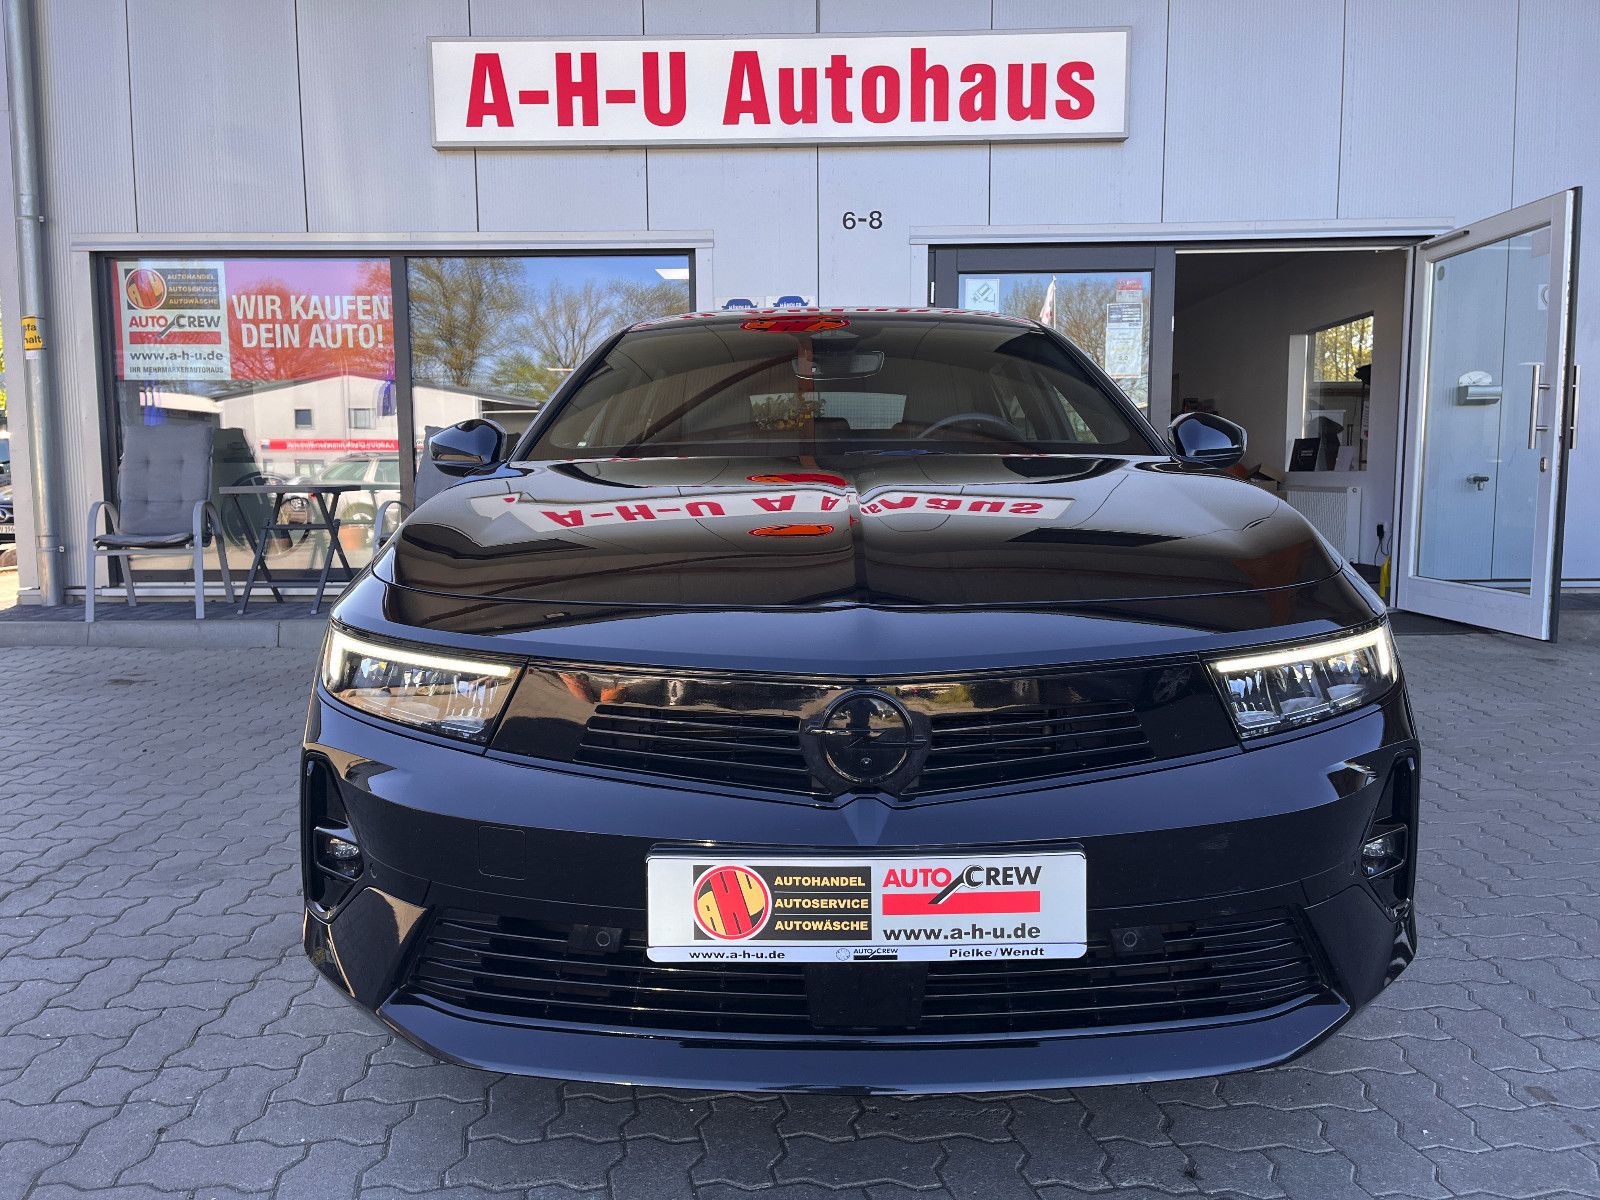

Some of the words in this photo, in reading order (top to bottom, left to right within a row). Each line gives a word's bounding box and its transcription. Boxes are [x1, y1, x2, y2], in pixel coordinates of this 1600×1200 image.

[465, 52, 687, 128] A-H-U
[722, 48, 1095, 126] Autohaus
[841, 210, 883, 230] 6-8
[232, 295, 282, 320] WIR
[291, 295, 390, 320] KAUFEN
[129, 315, 168, 328] AUTO
[176, 313, 221, 328] CREW
[241, 324, 303, 348] DEIN
[308, 324, 384, 348] AUTO!
[130, 350, 224, 361] www.a-h-u.de
[774, 875, 866, 888] AUTOHANDEL
[883, 868, 952, 888] AUTO
[964, 864, 1042, 886] CREW
[774, 898, 869, 910] AUTOSERVICE
[774, 918, 869, 932] AUTOWÄSCHE
[883, 922, 1041, 941] www.a-h-u.de
[688, 949, 786, 960] www.a-h-u.de
